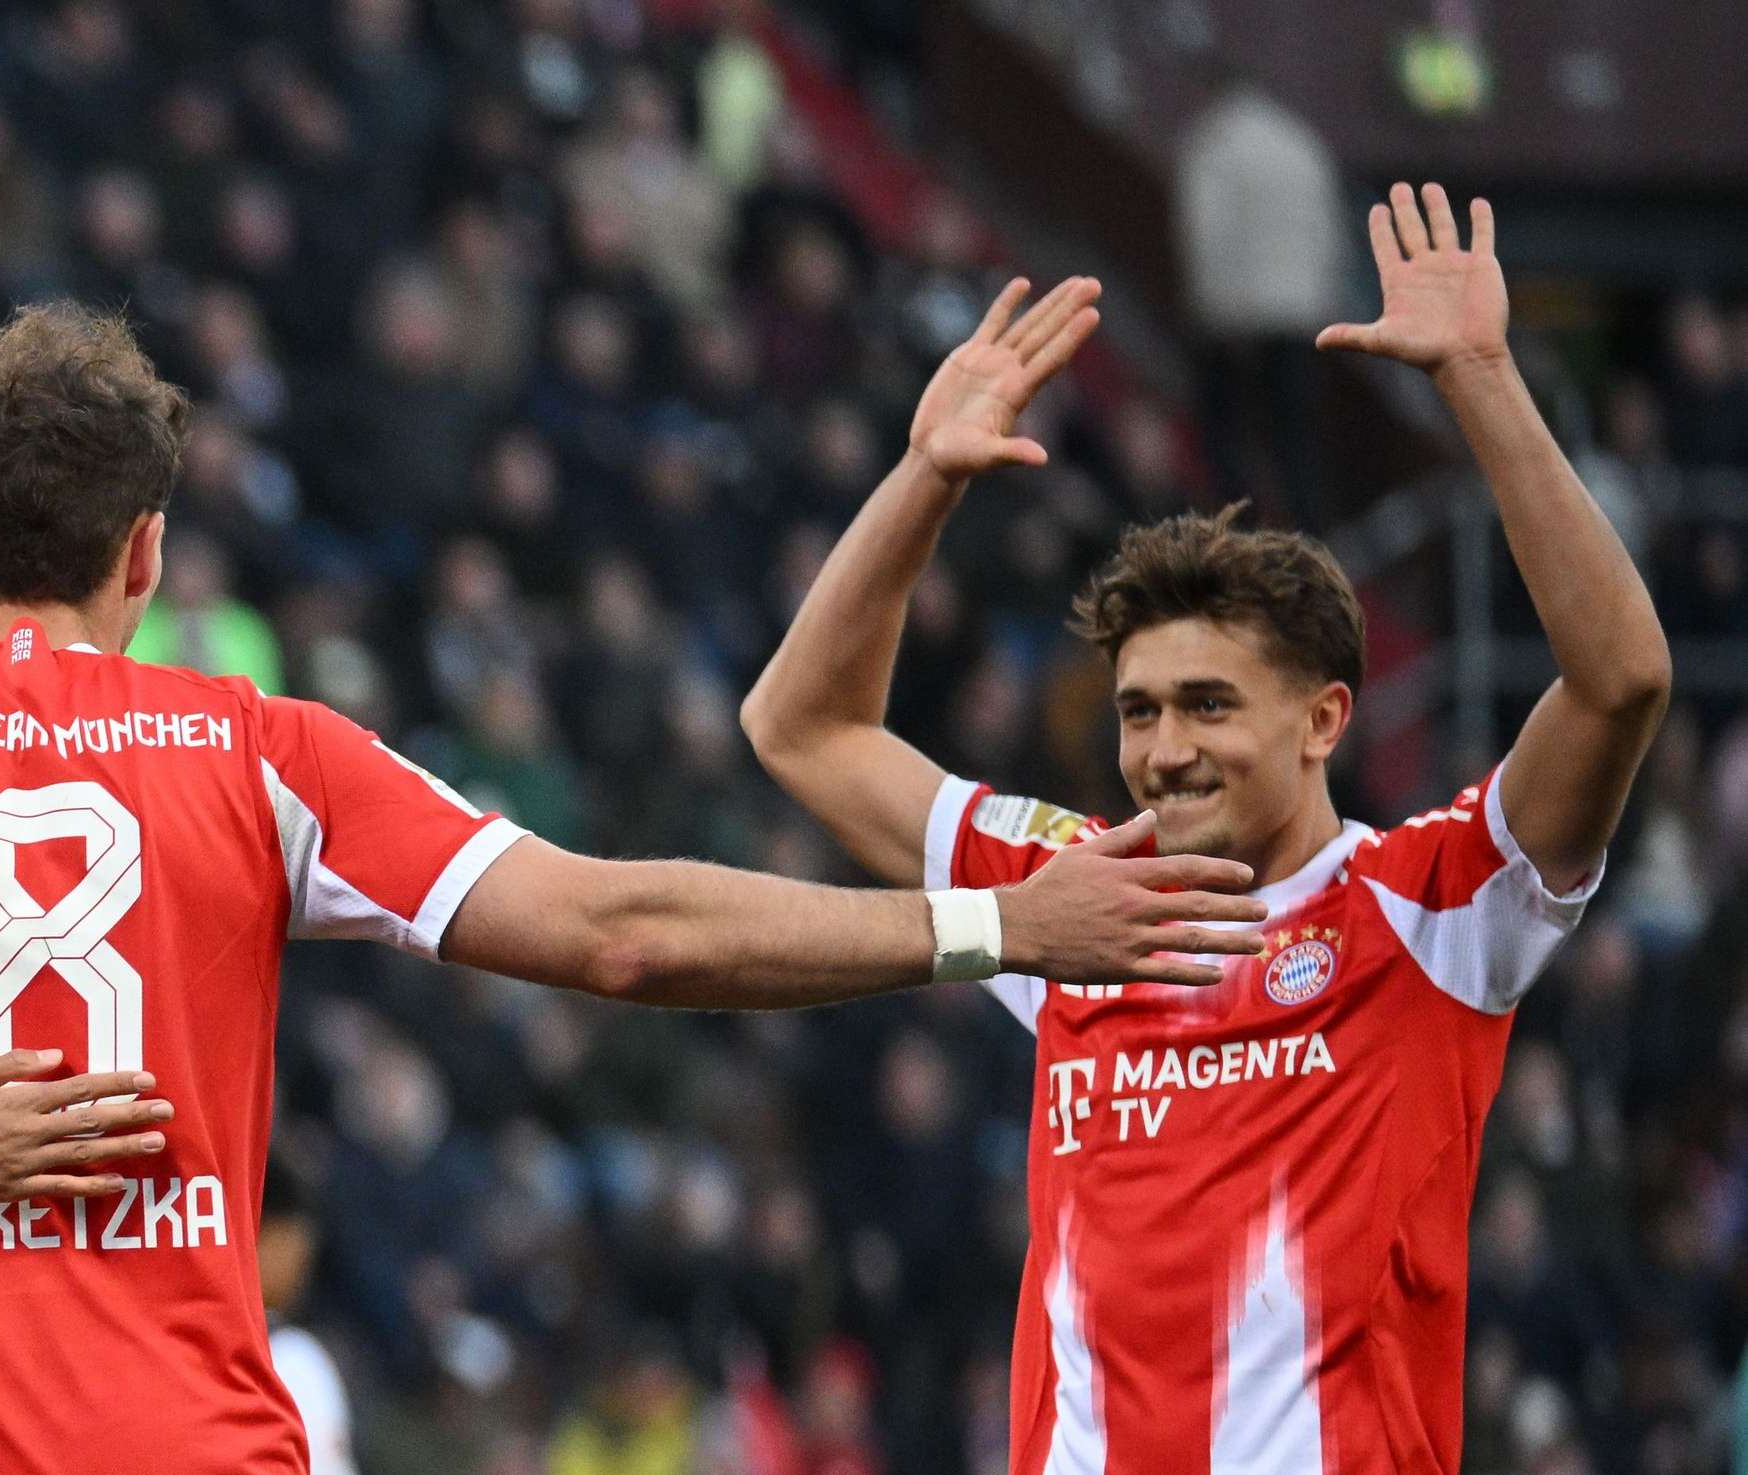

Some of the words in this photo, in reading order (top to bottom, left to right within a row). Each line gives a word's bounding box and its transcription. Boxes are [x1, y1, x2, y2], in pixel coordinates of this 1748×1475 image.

[52, 711, 232, 760] MÜNCHEN
[1111, 1031, 1337, 1093] MAGENTA
[1110, 1095, 1173, 1141] TV
